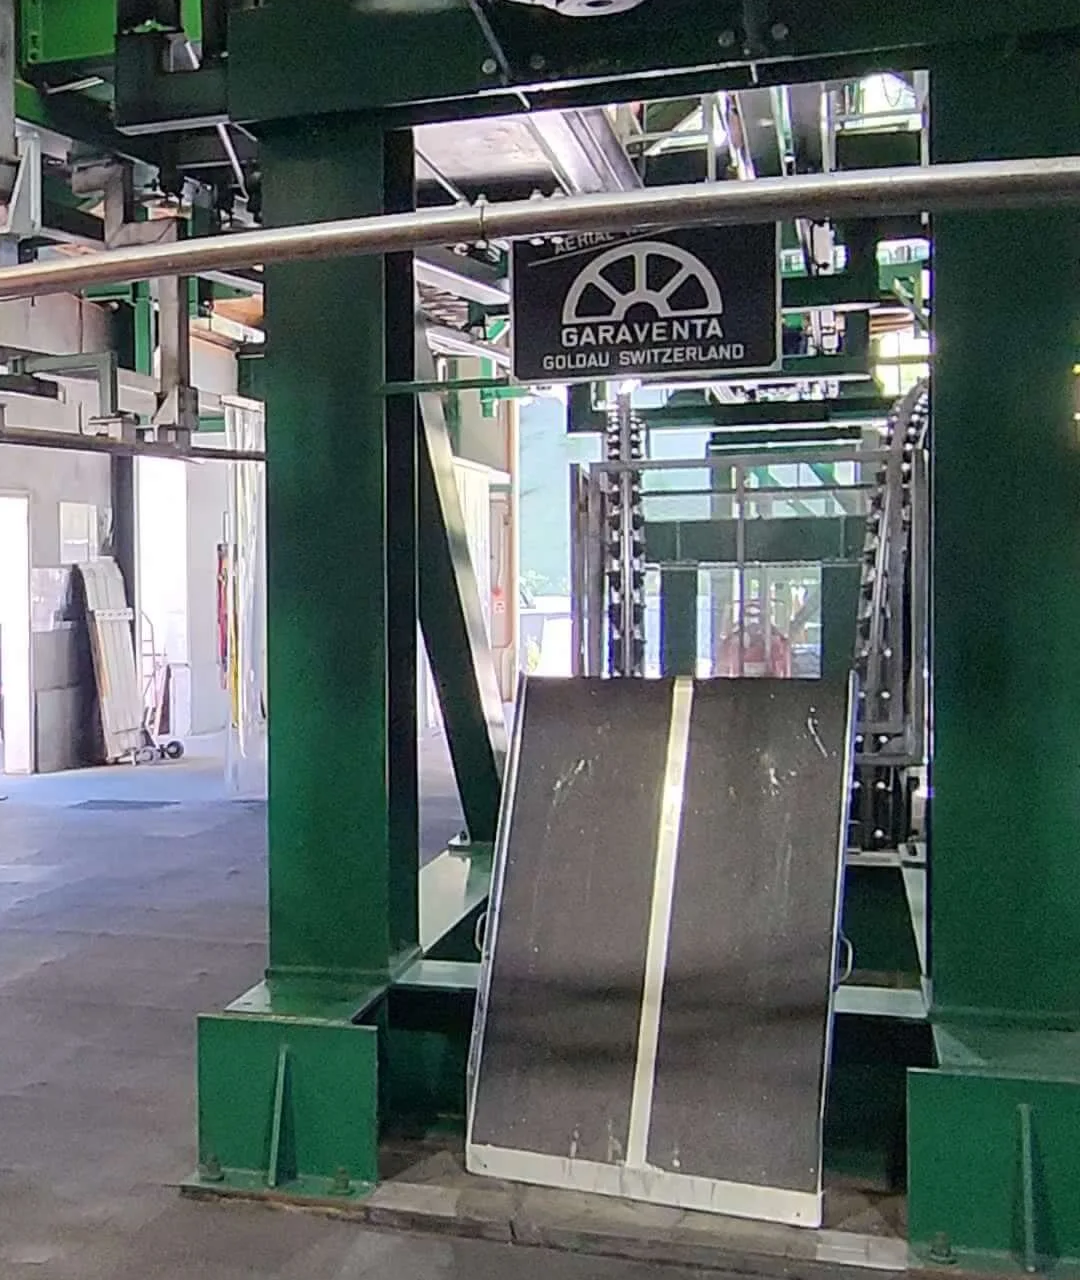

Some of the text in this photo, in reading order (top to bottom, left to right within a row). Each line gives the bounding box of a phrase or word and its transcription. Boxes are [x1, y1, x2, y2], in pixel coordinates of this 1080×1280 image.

[561, 319, 723, 348] GARAVENTA
[543, 343, 745, 370] GOLDAU SWITZERLAND
